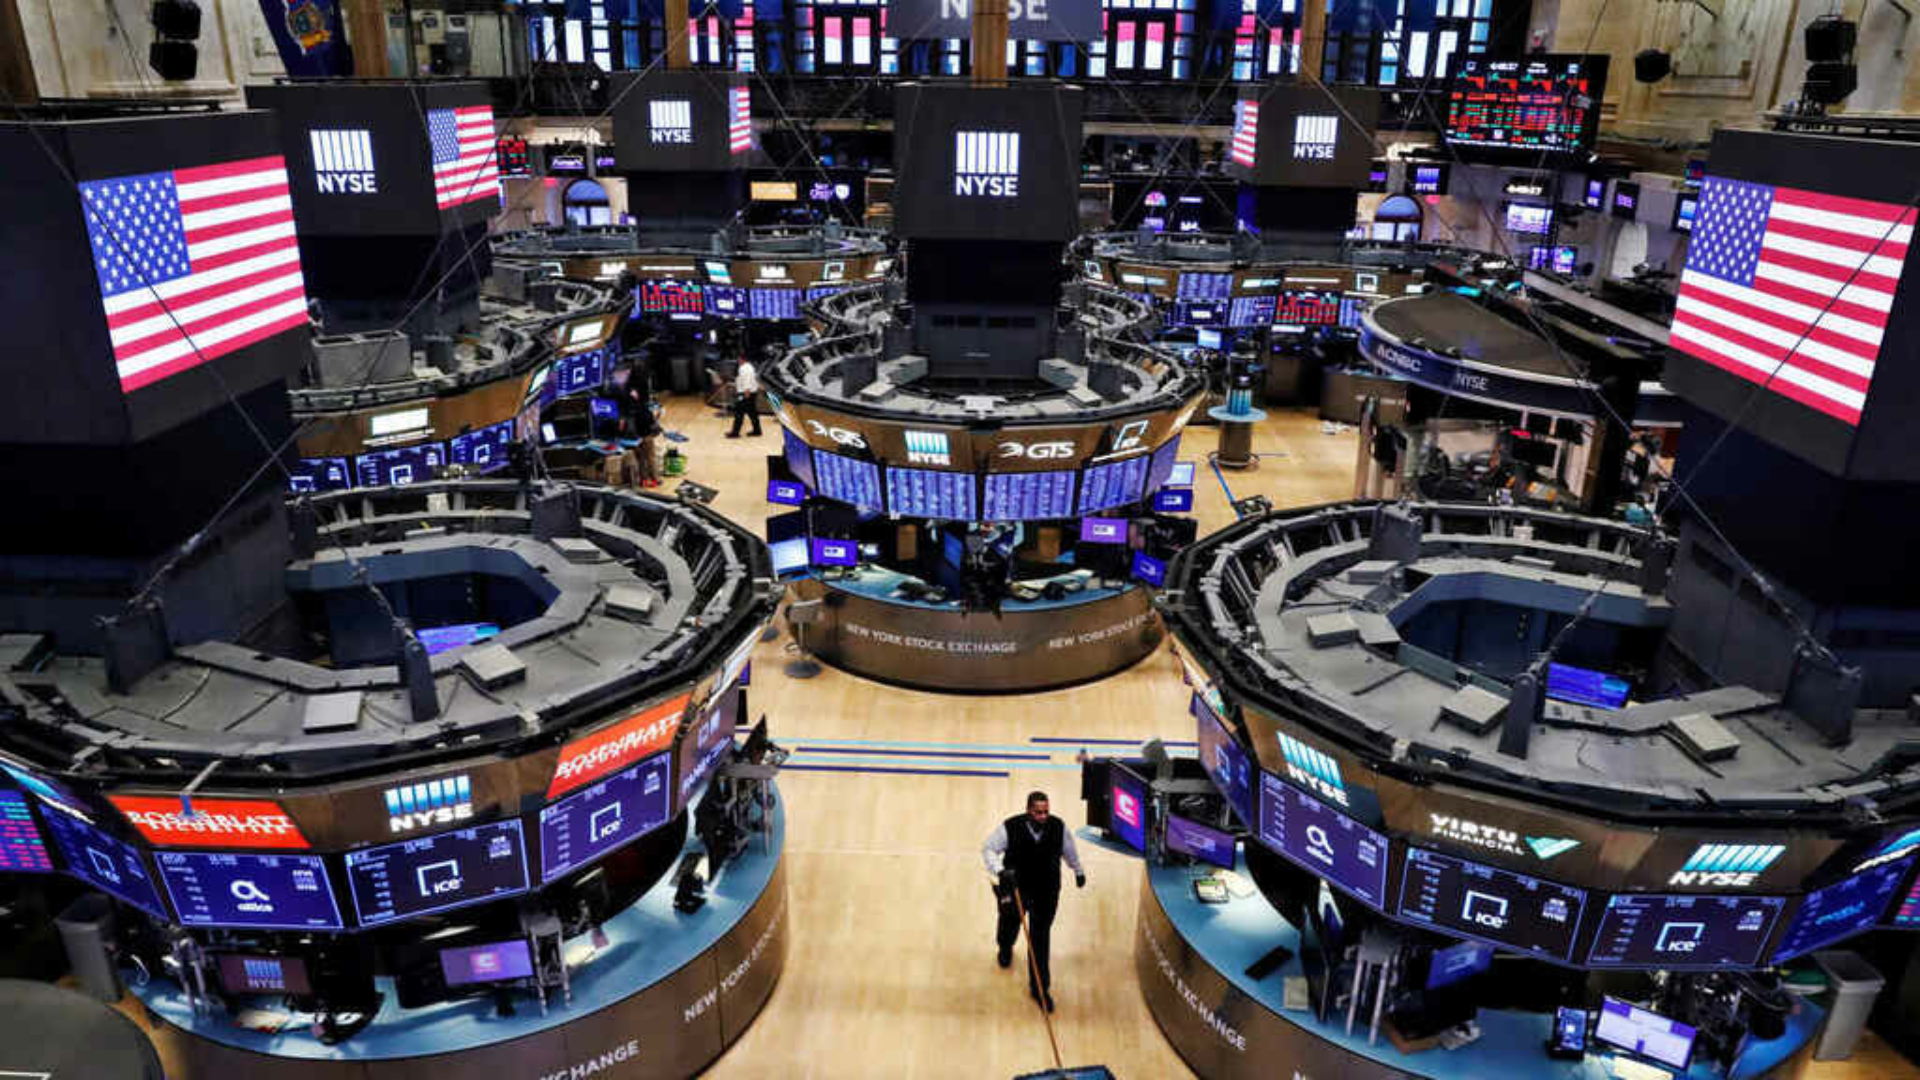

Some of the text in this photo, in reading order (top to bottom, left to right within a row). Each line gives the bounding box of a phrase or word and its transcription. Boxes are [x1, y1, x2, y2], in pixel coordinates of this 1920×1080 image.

[942, 0, 1048, 20] NSE
[652, 129, 691, 142] NYSE
[1293, 144, 1335, 158] NYSE
[317, 173, 378, 193] NYSE
[956, 176, 1019, 196] NYSE
[1456, 372, 1490, 391] NYSE
[1027, 442, 1075, 459] GTS
[872, 630, 902, 645] YORK
[905, 636, 945, 650] STOCK
[948, 641, 1017, 652] EXCHANGE
[1287, 763, 1350, 807] NYSE
[389, 803, 474, 832] NYSE
[1430, 813, 1518, 843] VIRTU
[1432, 826, 1525, 856] FINANCIAL
[1668, 871, 1760, 886] NYSE
[684, 986, 718, 1021] NEW
